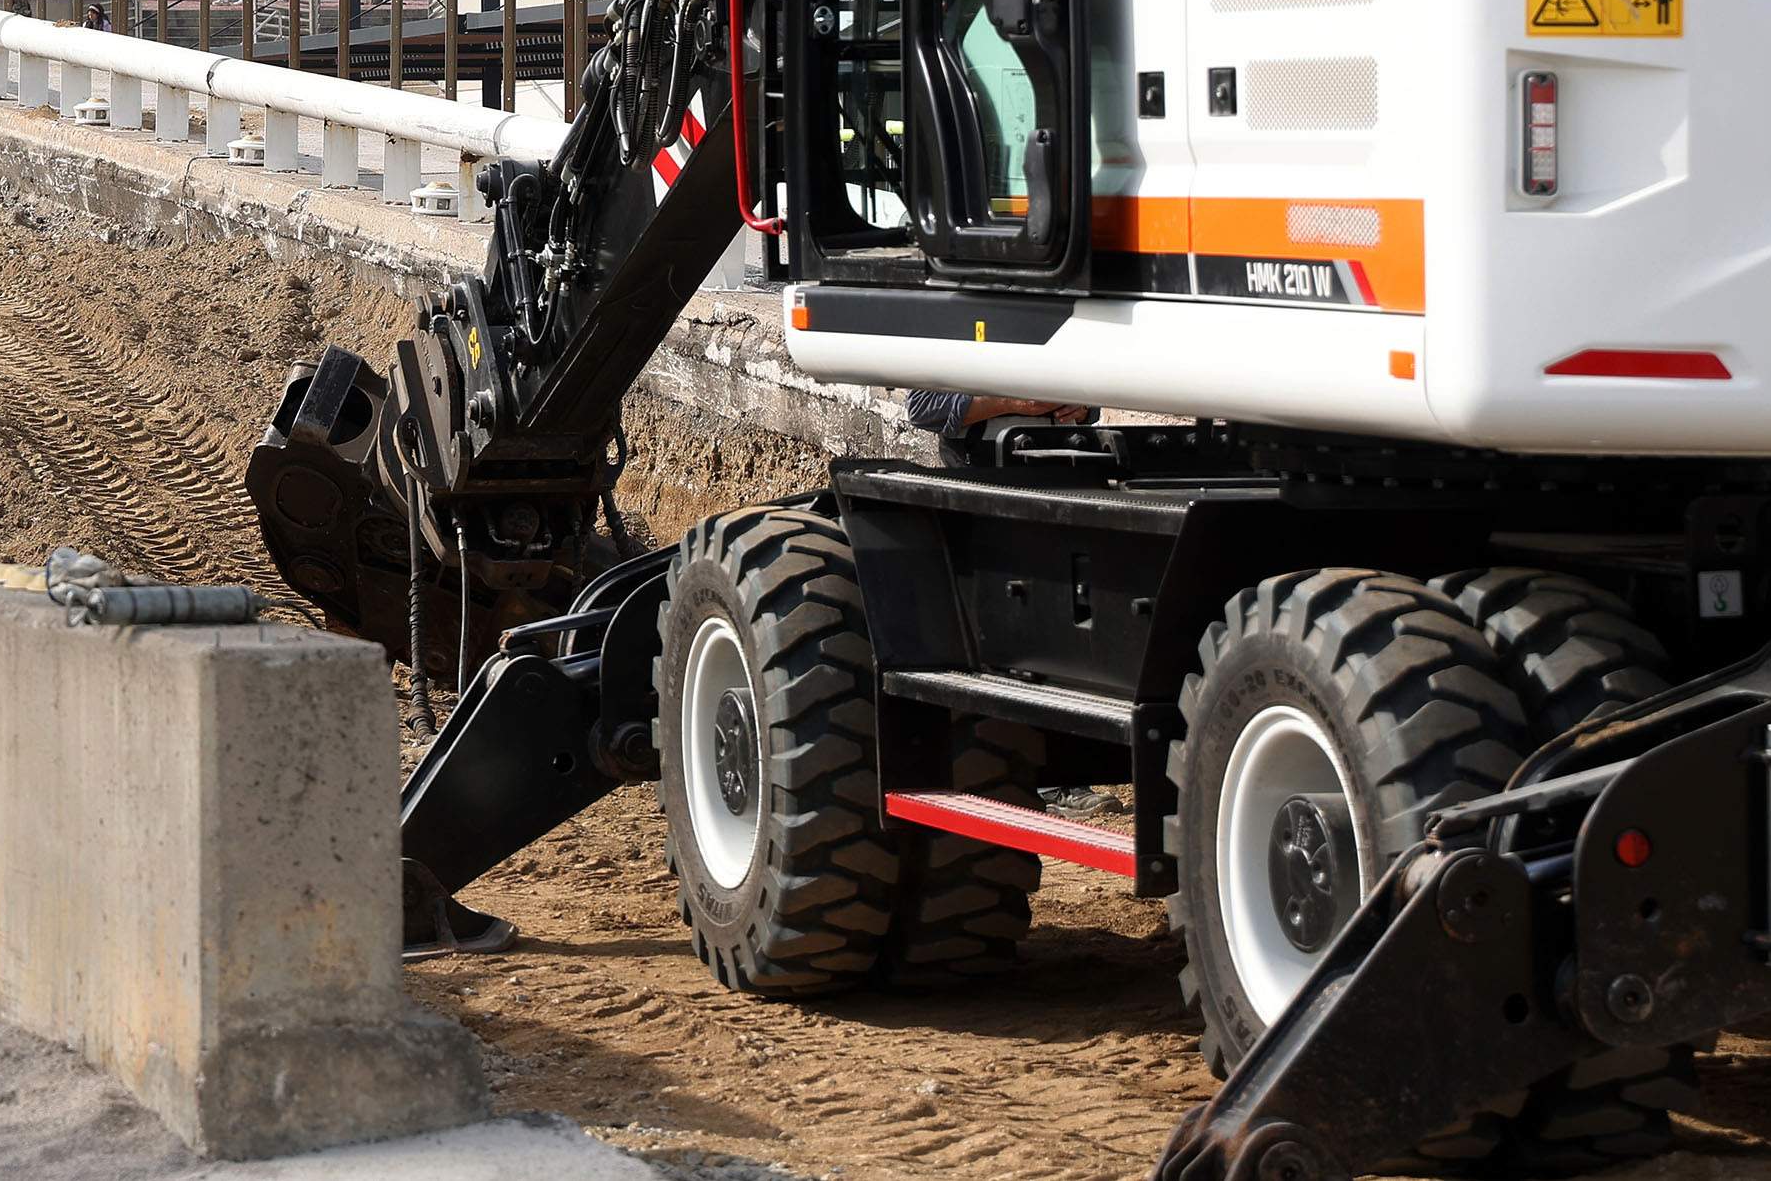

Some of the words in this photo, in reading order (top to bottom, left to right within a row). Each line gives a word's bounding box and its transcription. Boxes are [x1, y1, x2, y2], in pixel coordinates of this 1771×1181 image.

[1245, 261, 1283, 294] HMK
[1283, 263, 1312, 297] 210
[1312, 265, 1333, 298] W
